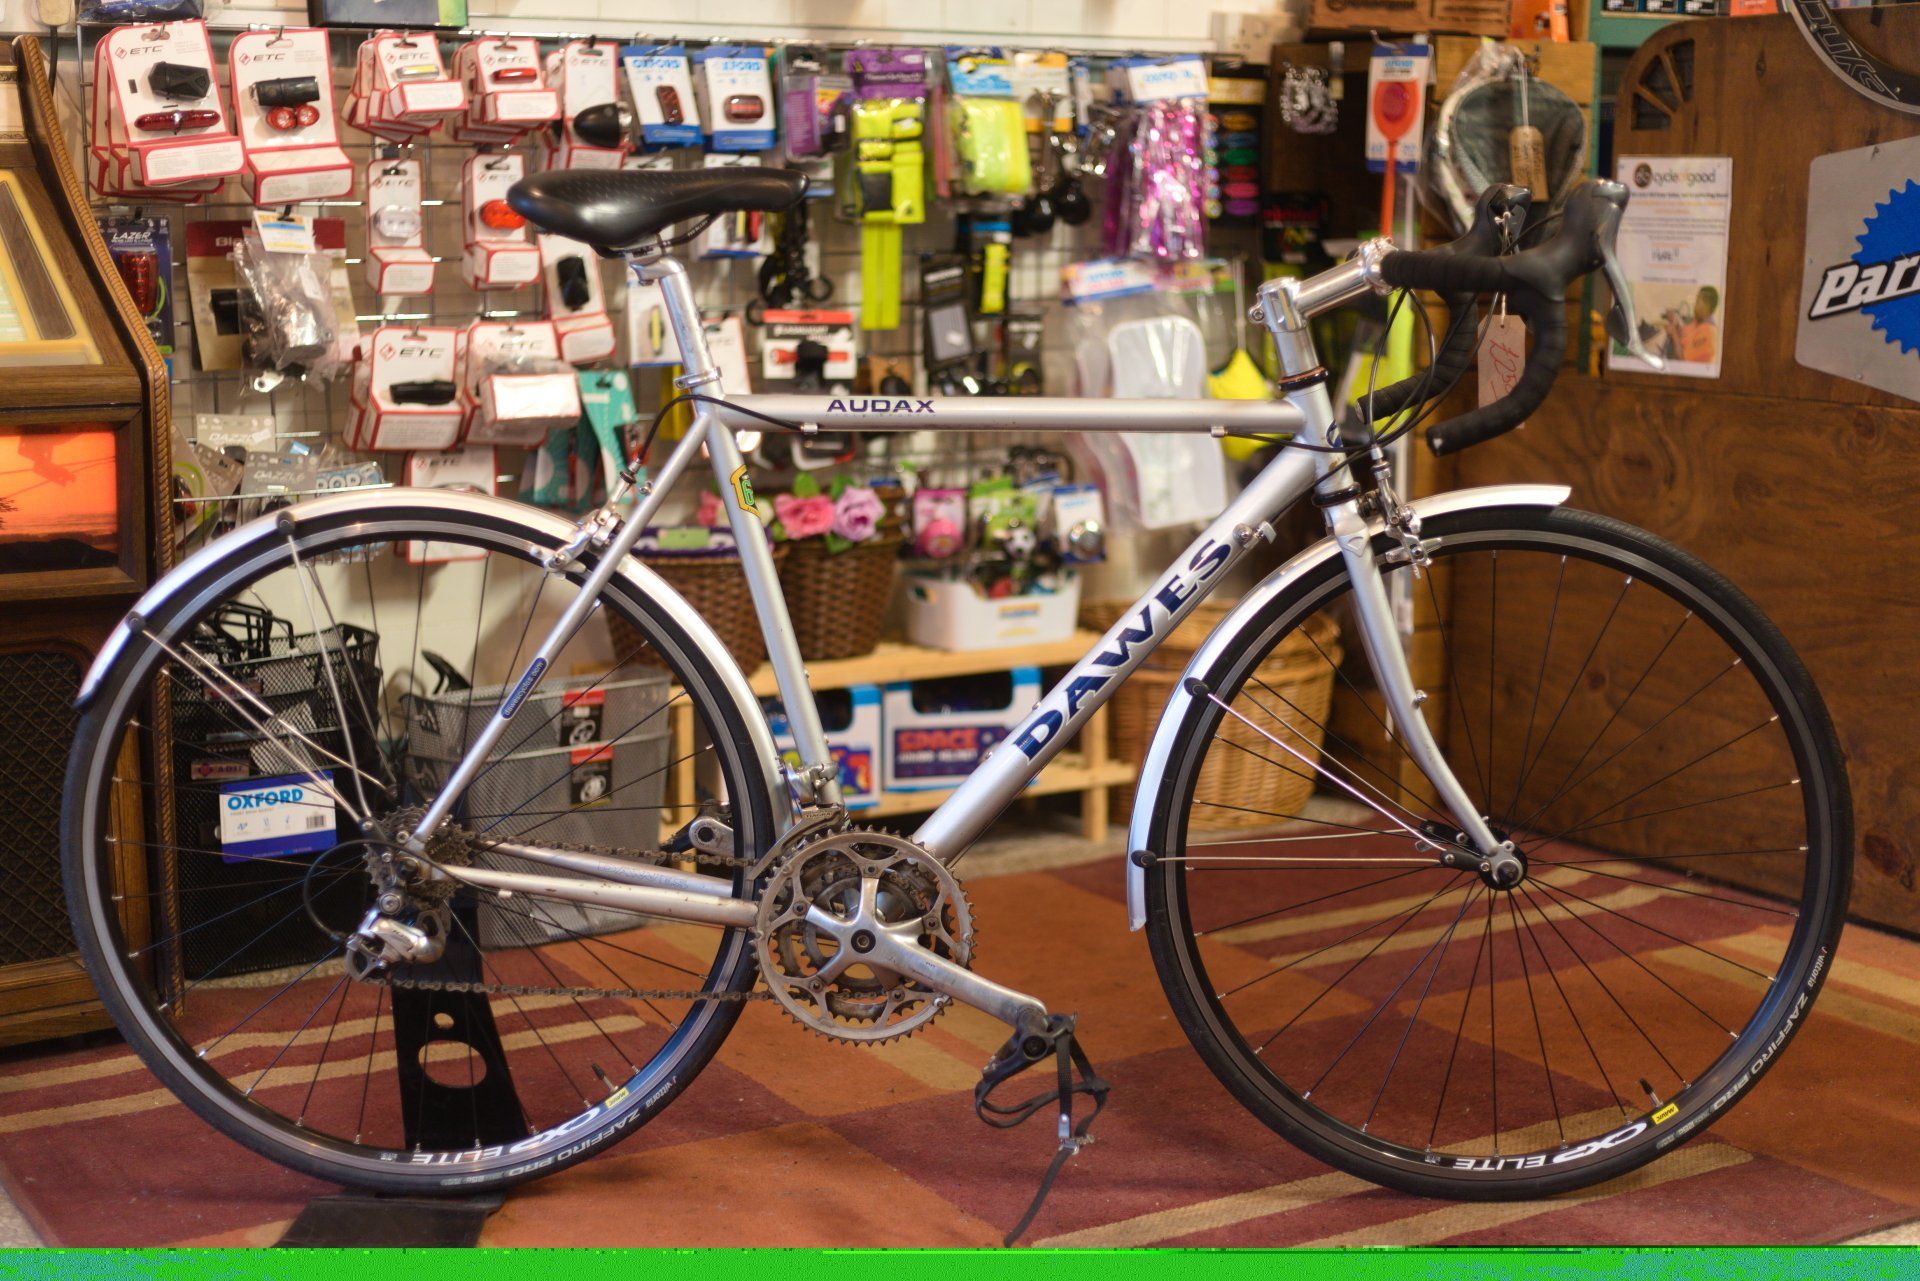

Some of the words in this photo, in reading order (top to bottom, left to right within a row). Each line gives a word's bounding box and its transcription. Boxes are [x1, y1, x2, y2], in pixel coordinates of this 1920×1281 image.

[129, 45, 163, 55] ETC
[253, 53, 286, 62] ETC
[398, 52, 430, 61] ETC
[498, 56, 529, 66] ETC
[112, 231, 152, 240] LAZER
[1810, 253, 1920, 319] Par
[399, 347, 445, 358] ETC
[500, 340, 545, 351] ETC
[826, 399, 936, 414] AUDAX
[1013, 538, 1232, 762] DAWES
[227, 788, 304, 811] OXFORD
[1807, 954, 1826, 988] vittoria
[1751, 992, 1809, 1076] ZAFFIRO
[645, 1082, 673, 1108] vittoria
[1712, 1072, 1750, 1111] PRO
[1655, 1106, 1676, 1122] MAVIC
[557, 1108, 641, 1162] ZAFFIRO
[411, 1145, 504, 1165] ELITE
[1452, 1154, 1547, 1171] ELITE
[508, 1157, 552, 1177] PRO
